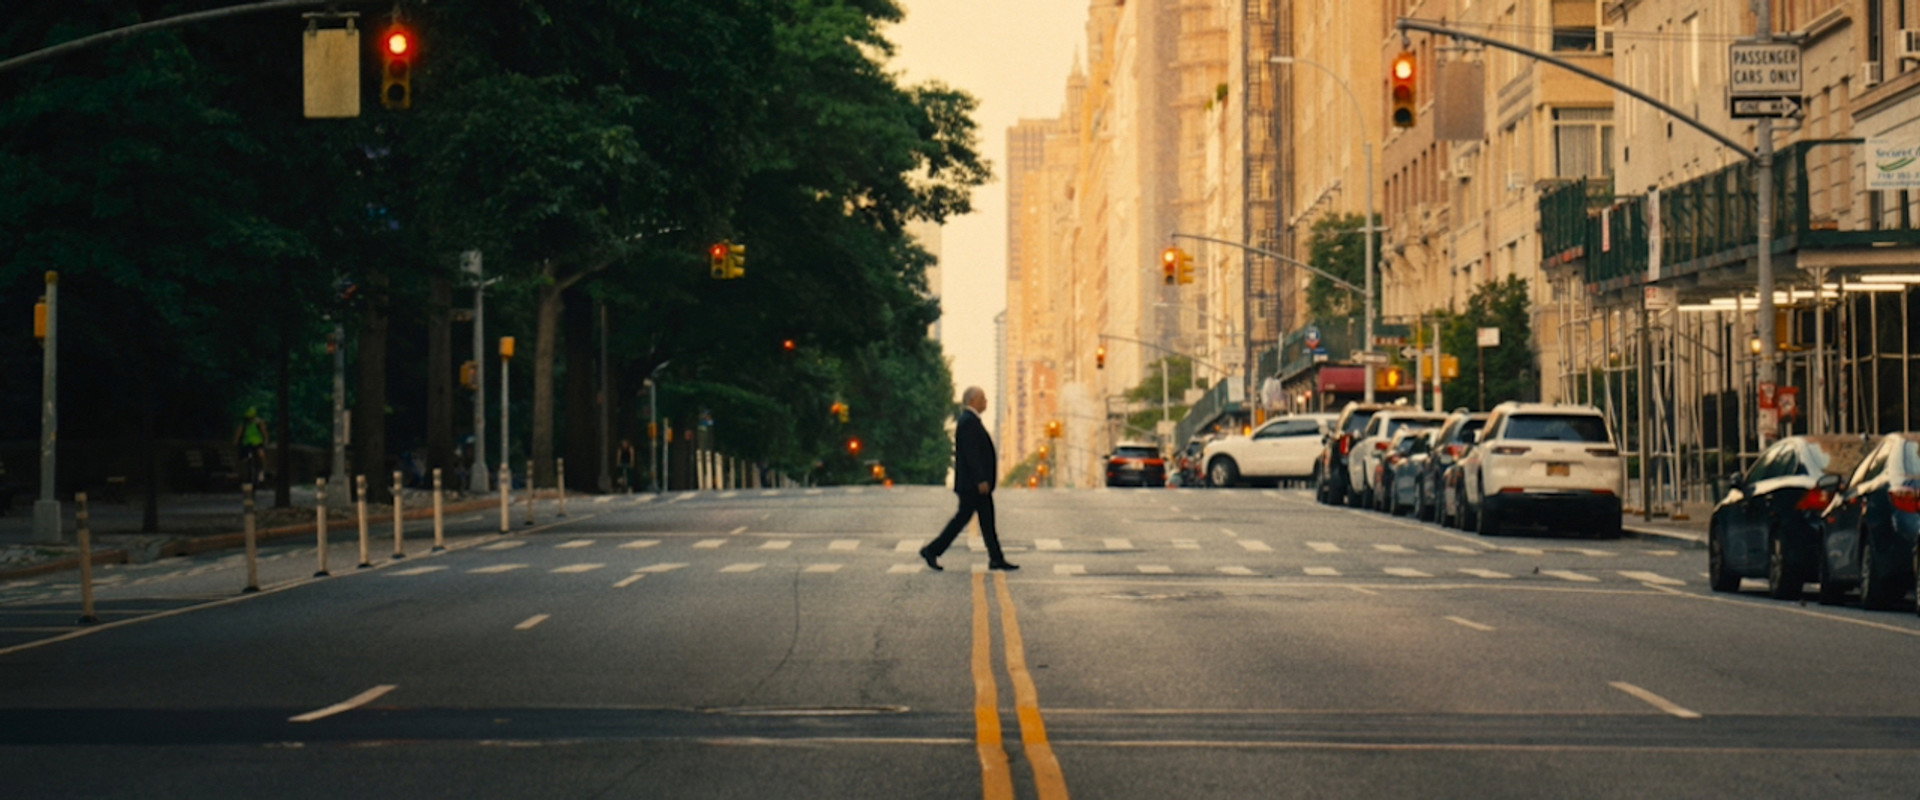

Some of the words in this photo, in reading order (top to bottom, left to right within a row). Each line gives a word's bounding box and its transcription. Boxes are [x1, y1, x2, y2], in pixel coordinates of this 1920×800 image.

[1734, 51, 1797, 65] PASSENGER
[1734, 70, 1763, 84] CARS
[1770, 69, 1798, 84] ONLY
[1741, 102, 1759, 111] ONE
[1771, 102, 1790, 111] WAY
